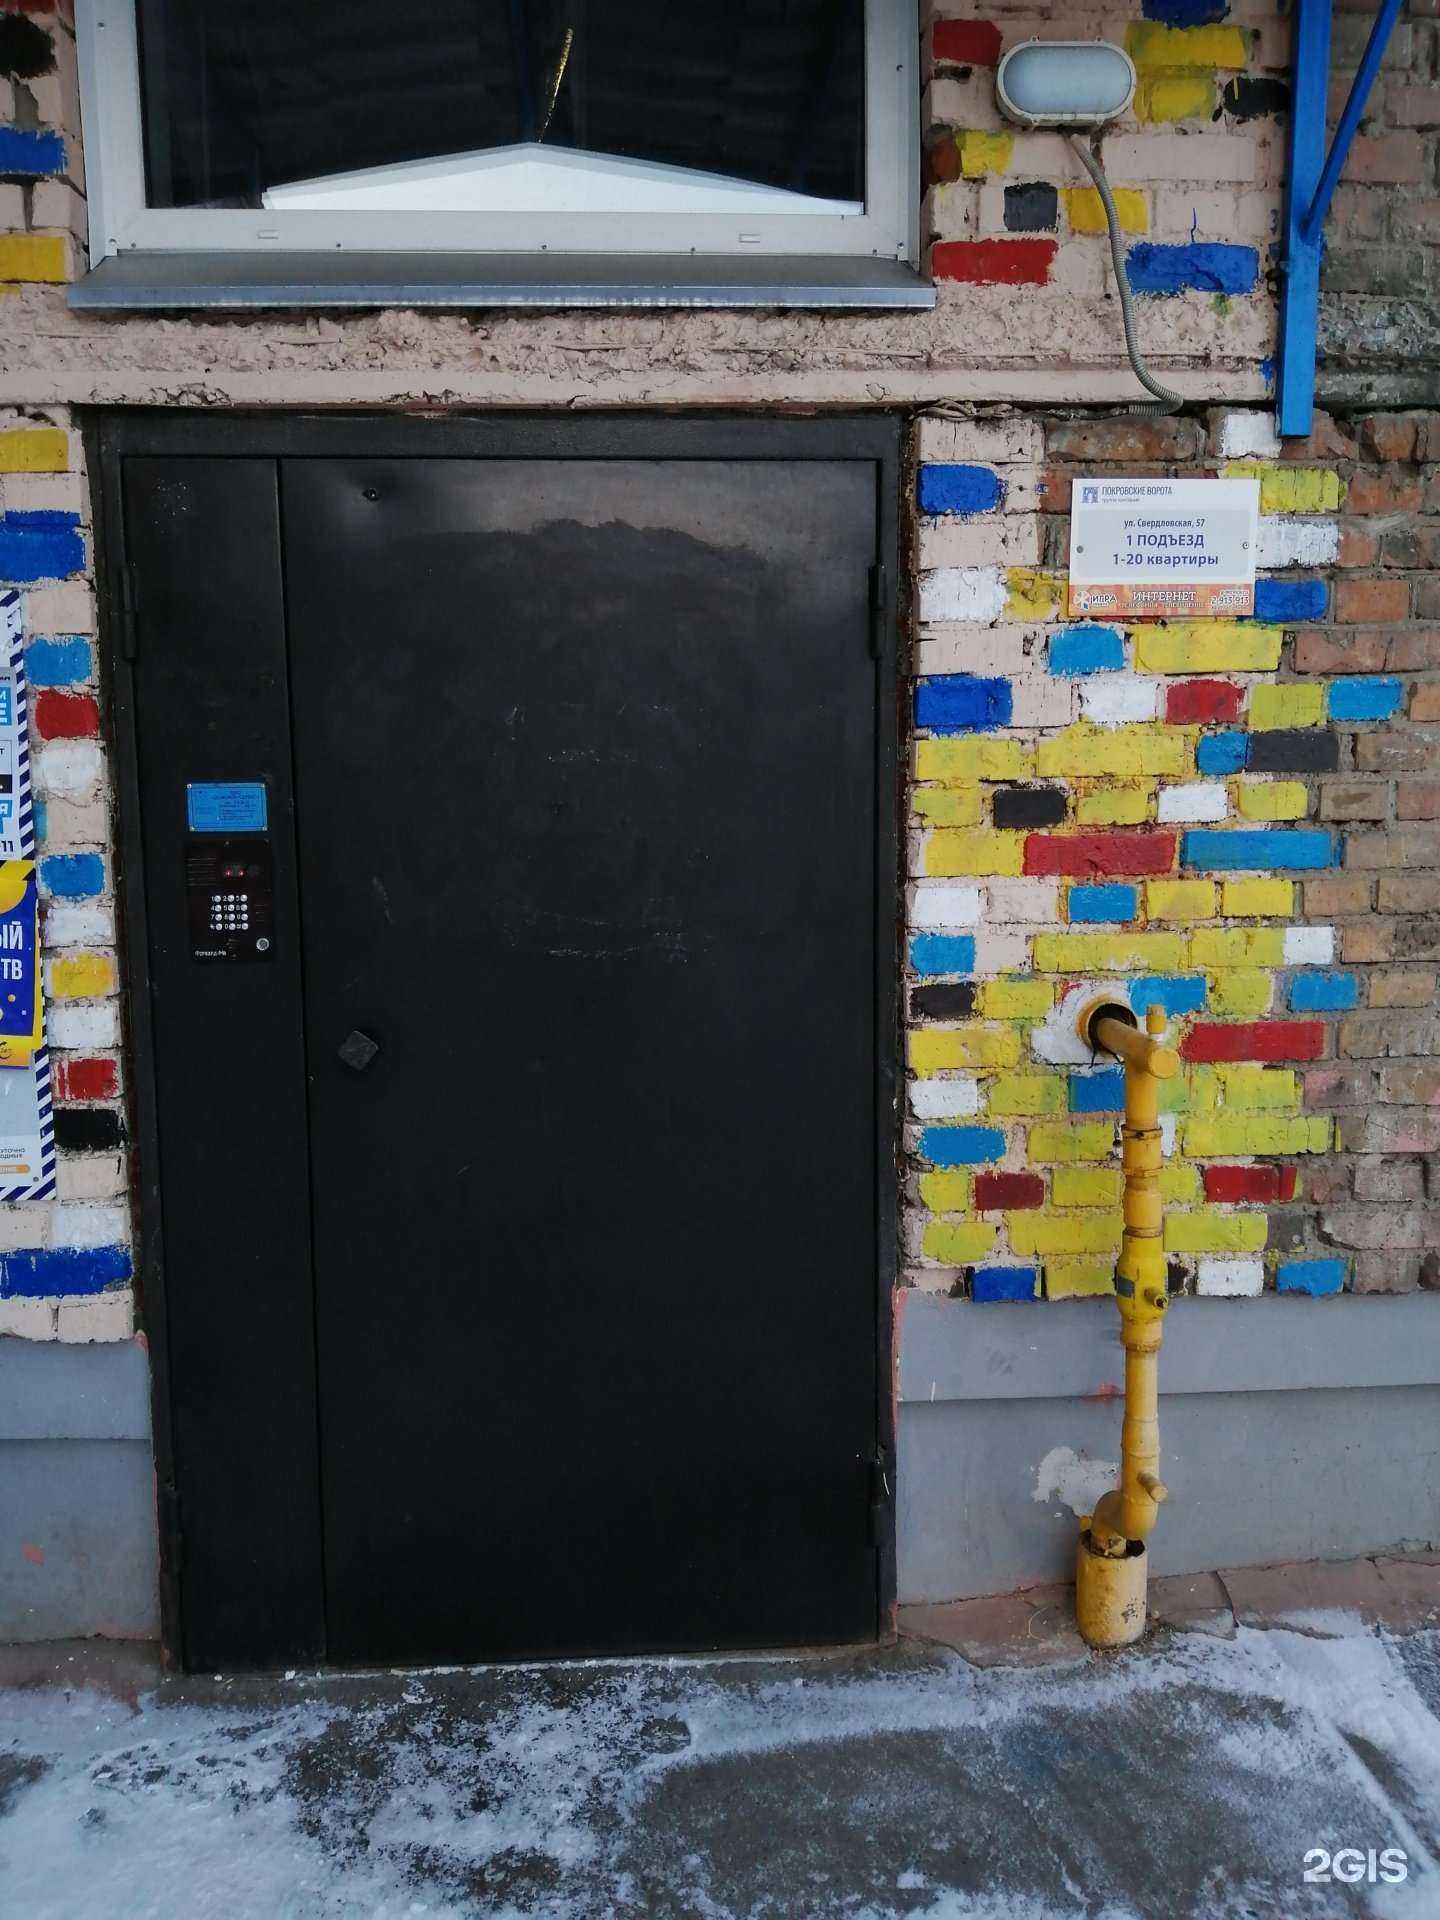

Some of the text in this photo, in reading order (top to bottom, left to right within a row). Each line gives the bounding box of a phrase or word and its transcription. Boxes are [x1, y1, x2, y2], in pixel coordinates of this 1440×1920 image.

[1102, 486, 1173, 496] ПОКРОВСКИЕ ВОРОТА
[1124, 518, 1205, 529] ул. Свердловская, 57
[1126, 534, 1205, 548] 1 ПОДЪЕЗД
[1113, 553, 1219, 568] 1-20 квартиры
[1132, 591, 1197, 601] ИНТЕРНЕТ
